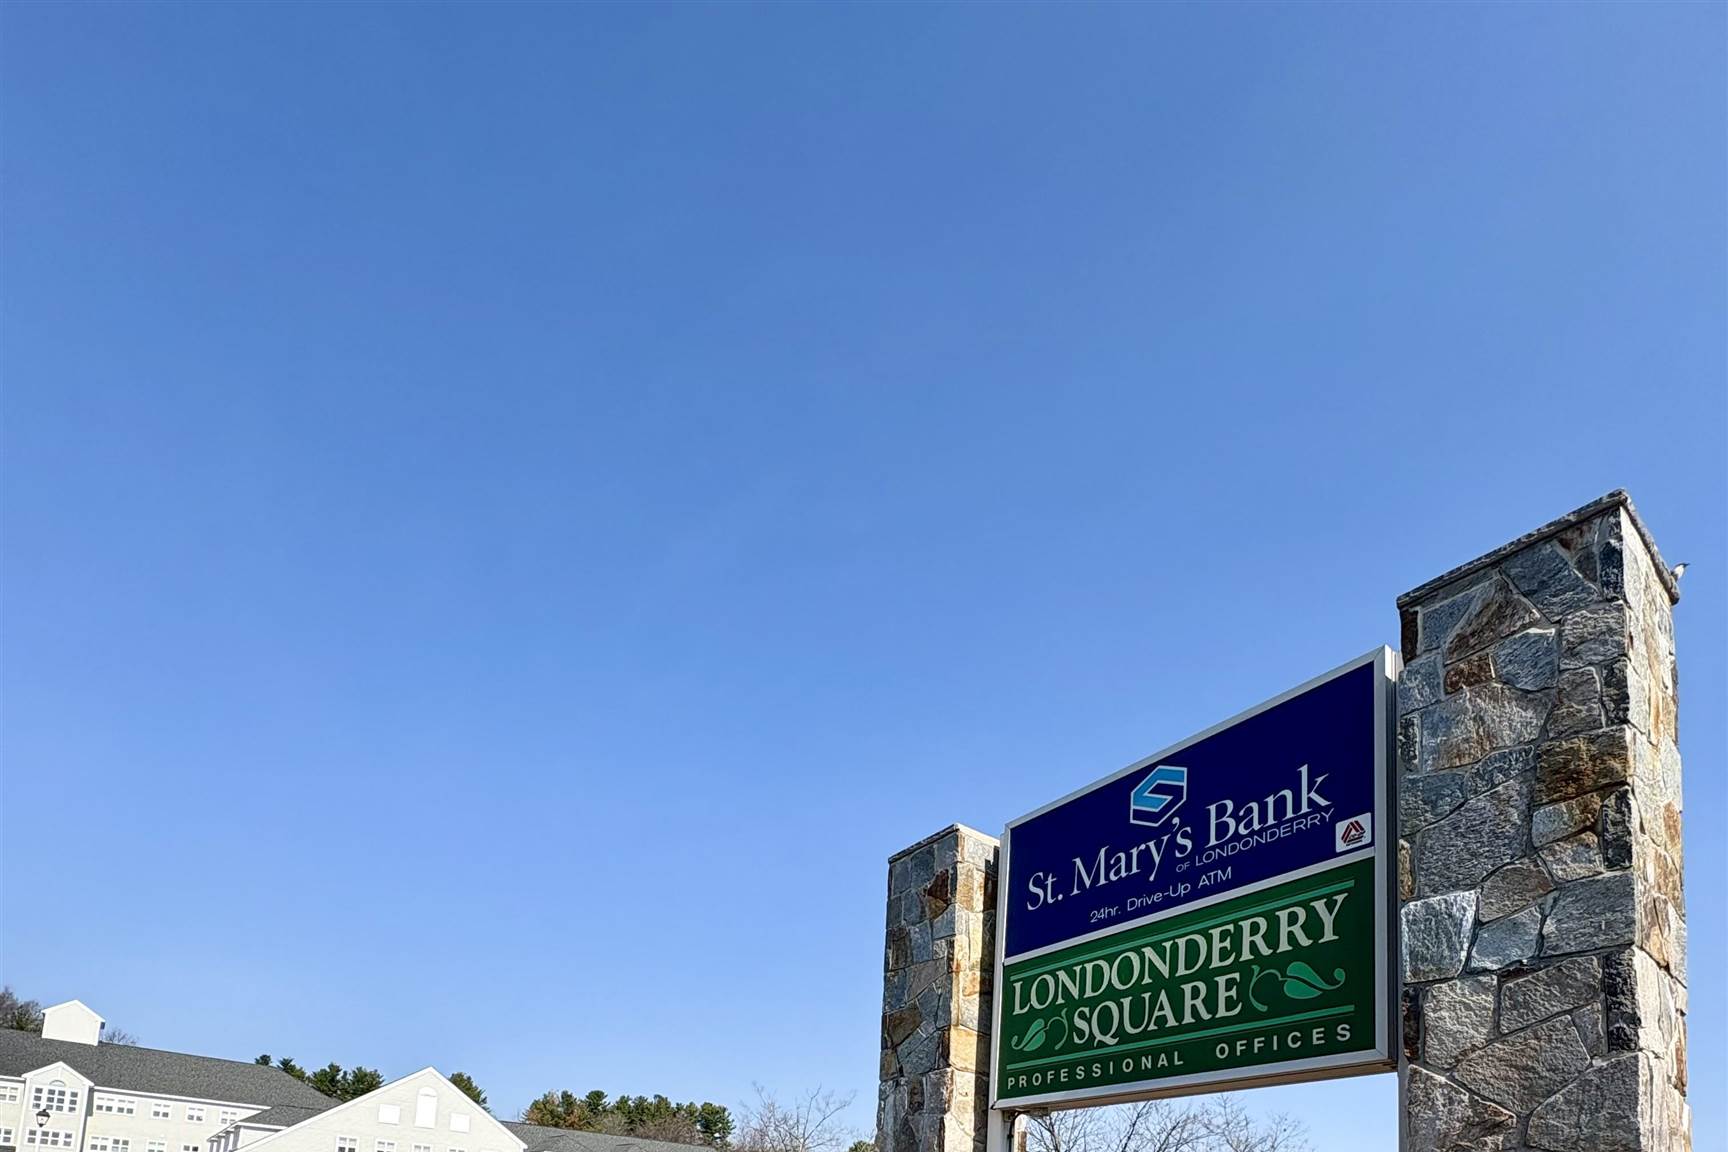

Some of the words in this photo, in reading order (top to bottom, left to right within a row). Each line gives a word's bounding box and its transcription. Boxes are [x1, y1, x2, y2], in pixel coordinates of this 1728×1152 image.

[1026, 871, 1064, 911] St.
[1204, 763, 1332, 849] Bank
[1175, 860, 1191, 873] OF
[1195, 808, 1335, 867] LONDONDERRY
[1090, 904, 1122, 923] 24hr.
[1126, 882, 1191, 911] Drive-Up
[1197, 865, 1232, 889] ATM
[1012, 892, 1349, 1016] LONDONDERRY
[1072, 972, 1243, 1047] SQUARE
[1007, 1051, 1184, 1089] PROFESSIONAL
[1215, 1024, 1351, 1059] OFFICES
